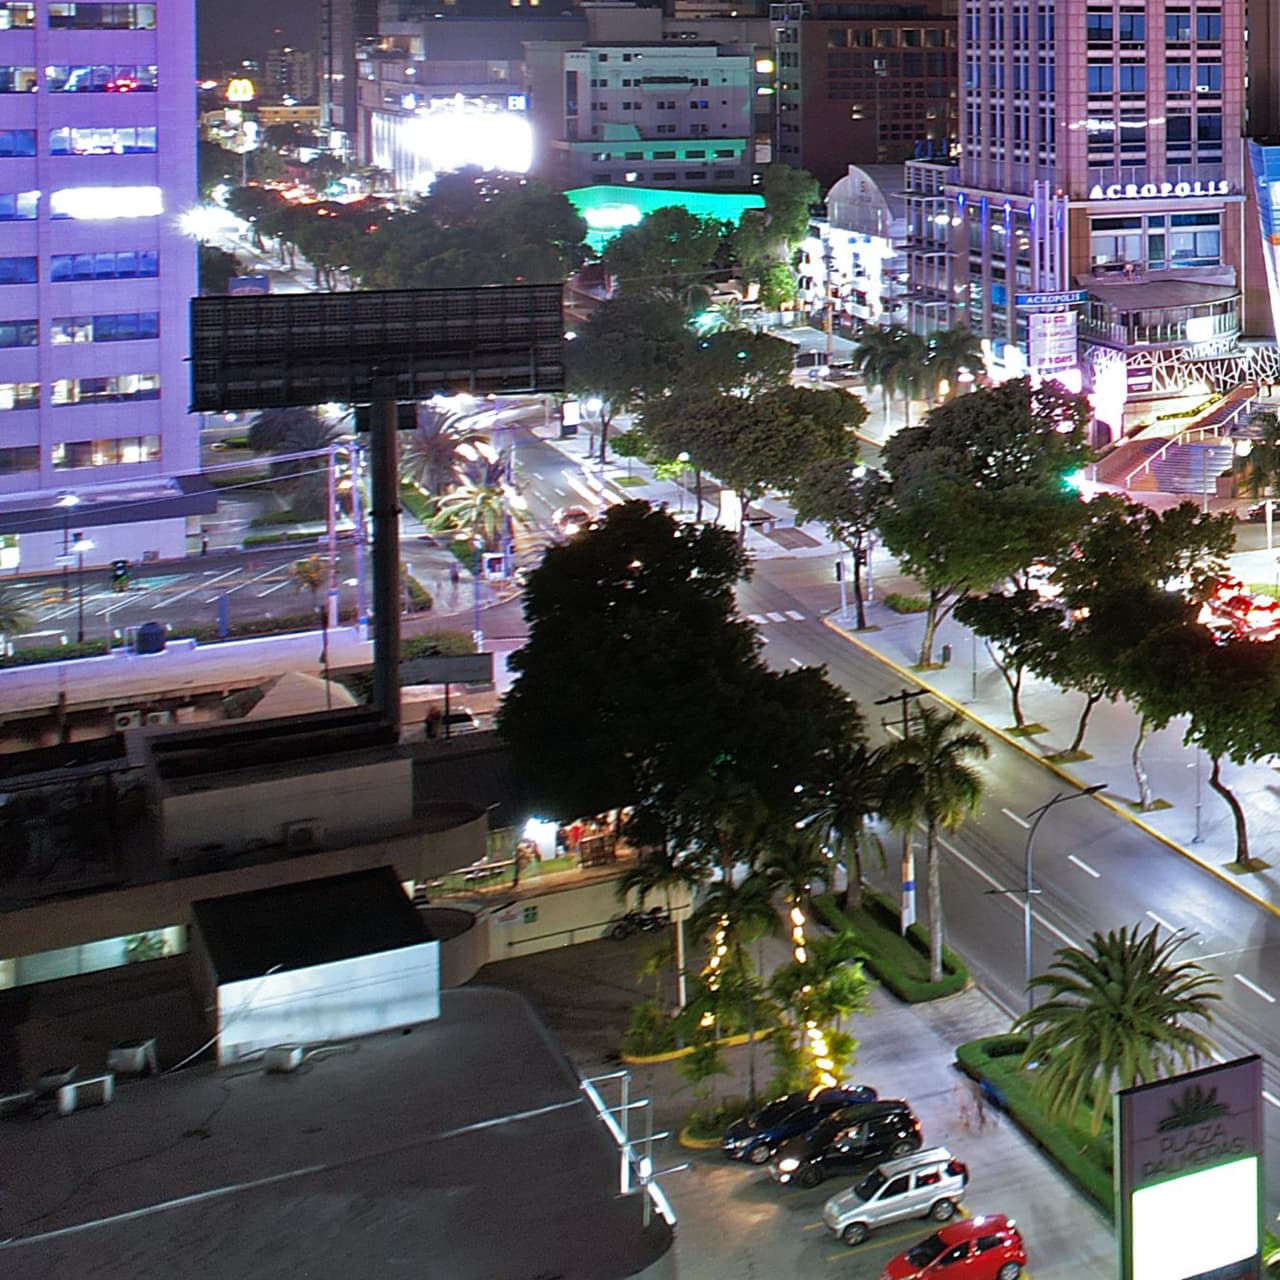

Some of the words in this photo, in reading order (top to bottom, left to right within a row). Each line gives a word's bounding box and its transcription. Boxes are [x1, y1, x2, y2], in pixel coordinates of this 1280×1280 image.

[1089, 180, 1229, 200] ACROPOLIS
[1026, 292, 1081, 304] ACROPOLIS
[1161, 1121, 1225, 1153] PLAZA
